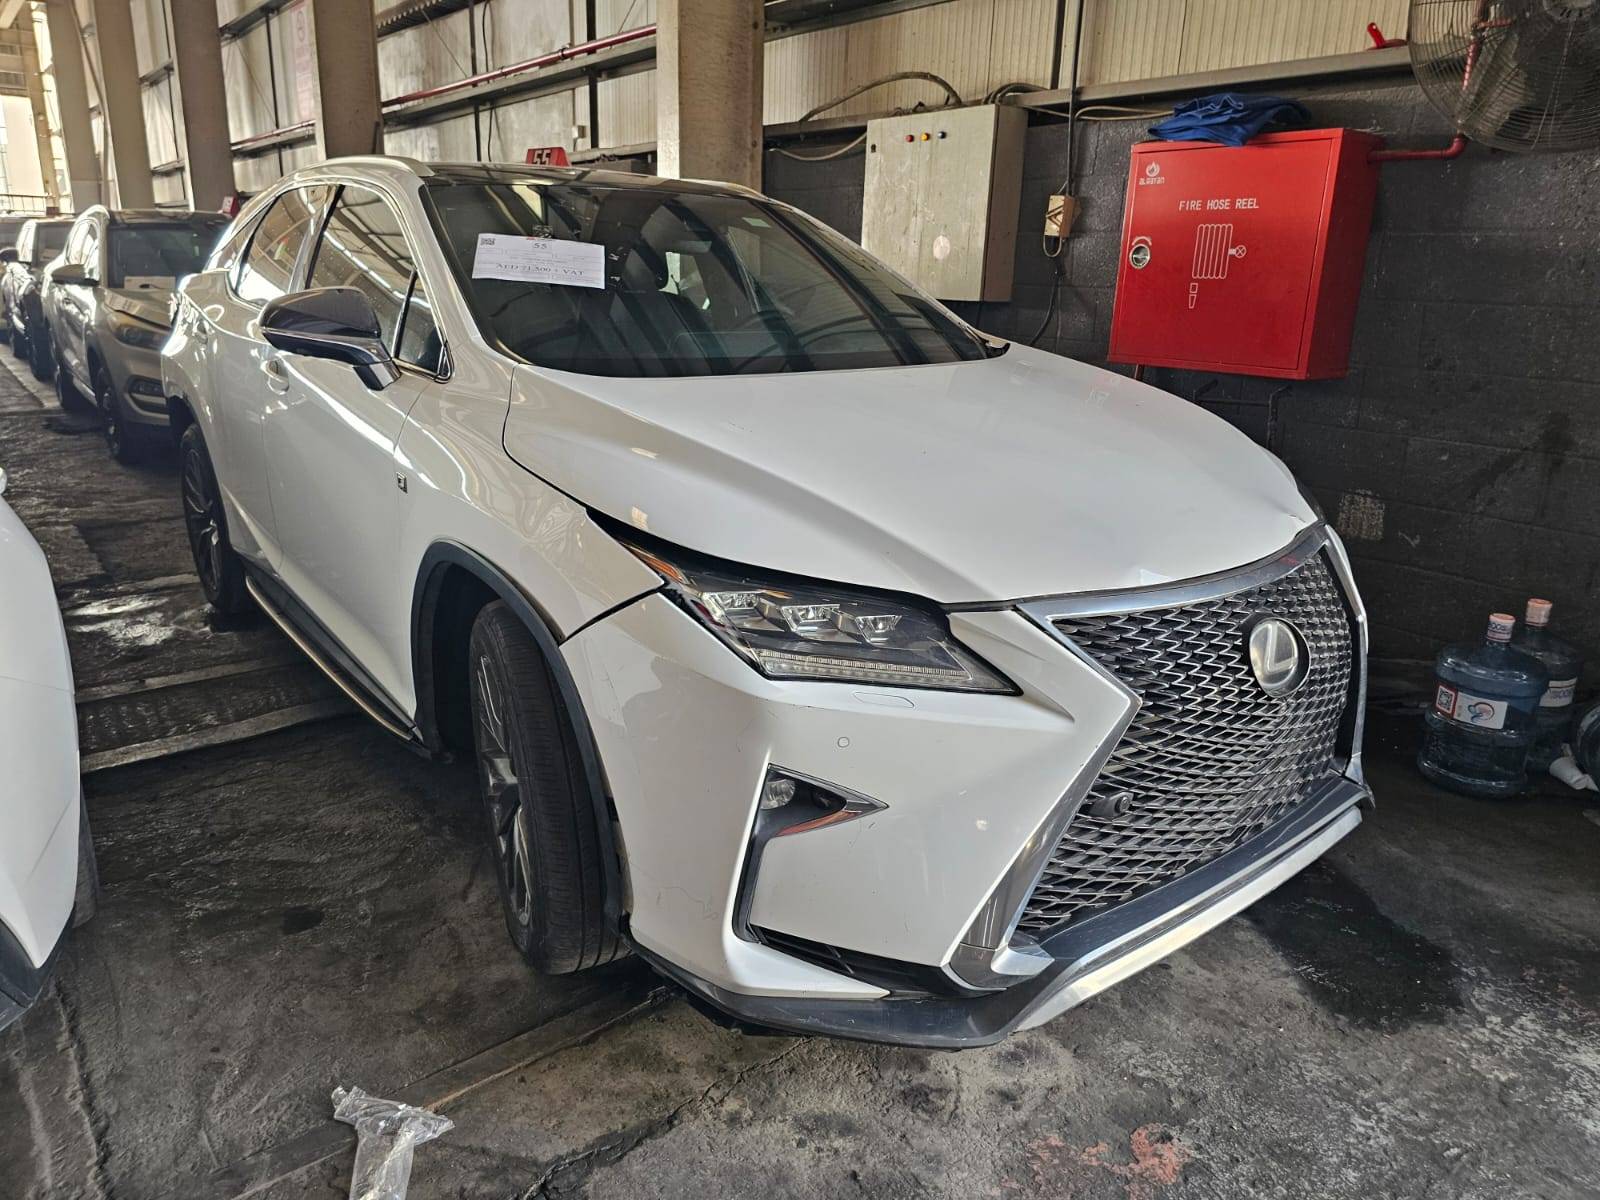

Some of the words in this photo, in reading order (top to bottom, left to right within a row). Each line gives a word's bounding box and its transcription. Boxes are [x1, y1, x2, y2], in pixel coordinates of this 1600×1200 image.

[533, 149, 551, 165] 55
[1178, 199, 1202, 211] FIRE
[1206, 198, 1231, 210] HOSE
[1235, 198, 1259, 209] REEL
[562, 268, 585, 276] VAT
